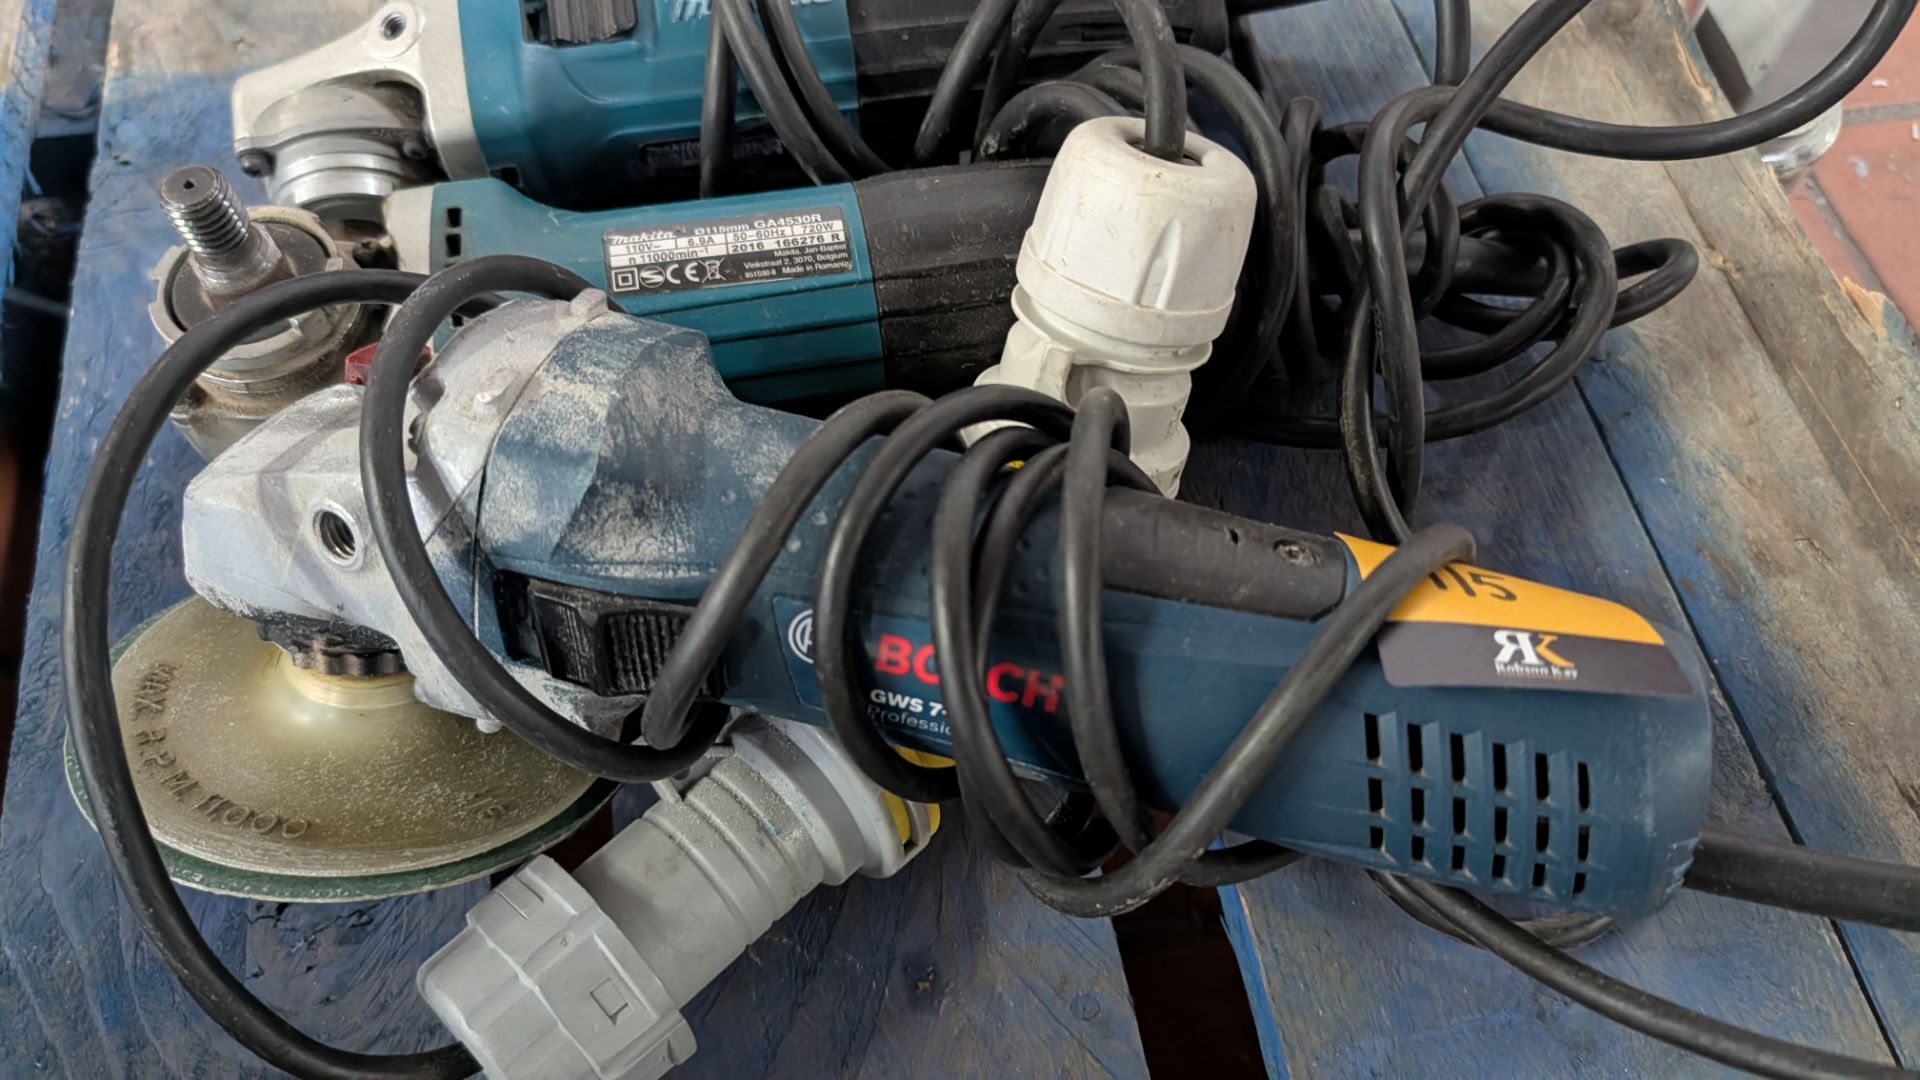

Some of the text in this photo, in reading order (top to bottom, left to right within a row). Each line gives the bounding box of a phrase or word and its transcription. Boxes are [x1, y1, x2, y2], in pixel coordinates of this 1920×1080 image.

[754, 213, 822, 229] GA4530R
[688, 236, 715, 247] 6.9A
[801, 222, 835, 234] 720W
[731, 242, 765, 253] 2016
[774, 234, 825, 247] 166276
[831, 233, 841, 242] R
[782, 264, 804, 274] Made
[815, 260, 850, 271] Romania
[816, 251, 849, 261] Belgium
[875, 633, 1065, 714] BOCH
[870, 689, 924, 713] GWS
[191, 793, 312, 839] 11000
